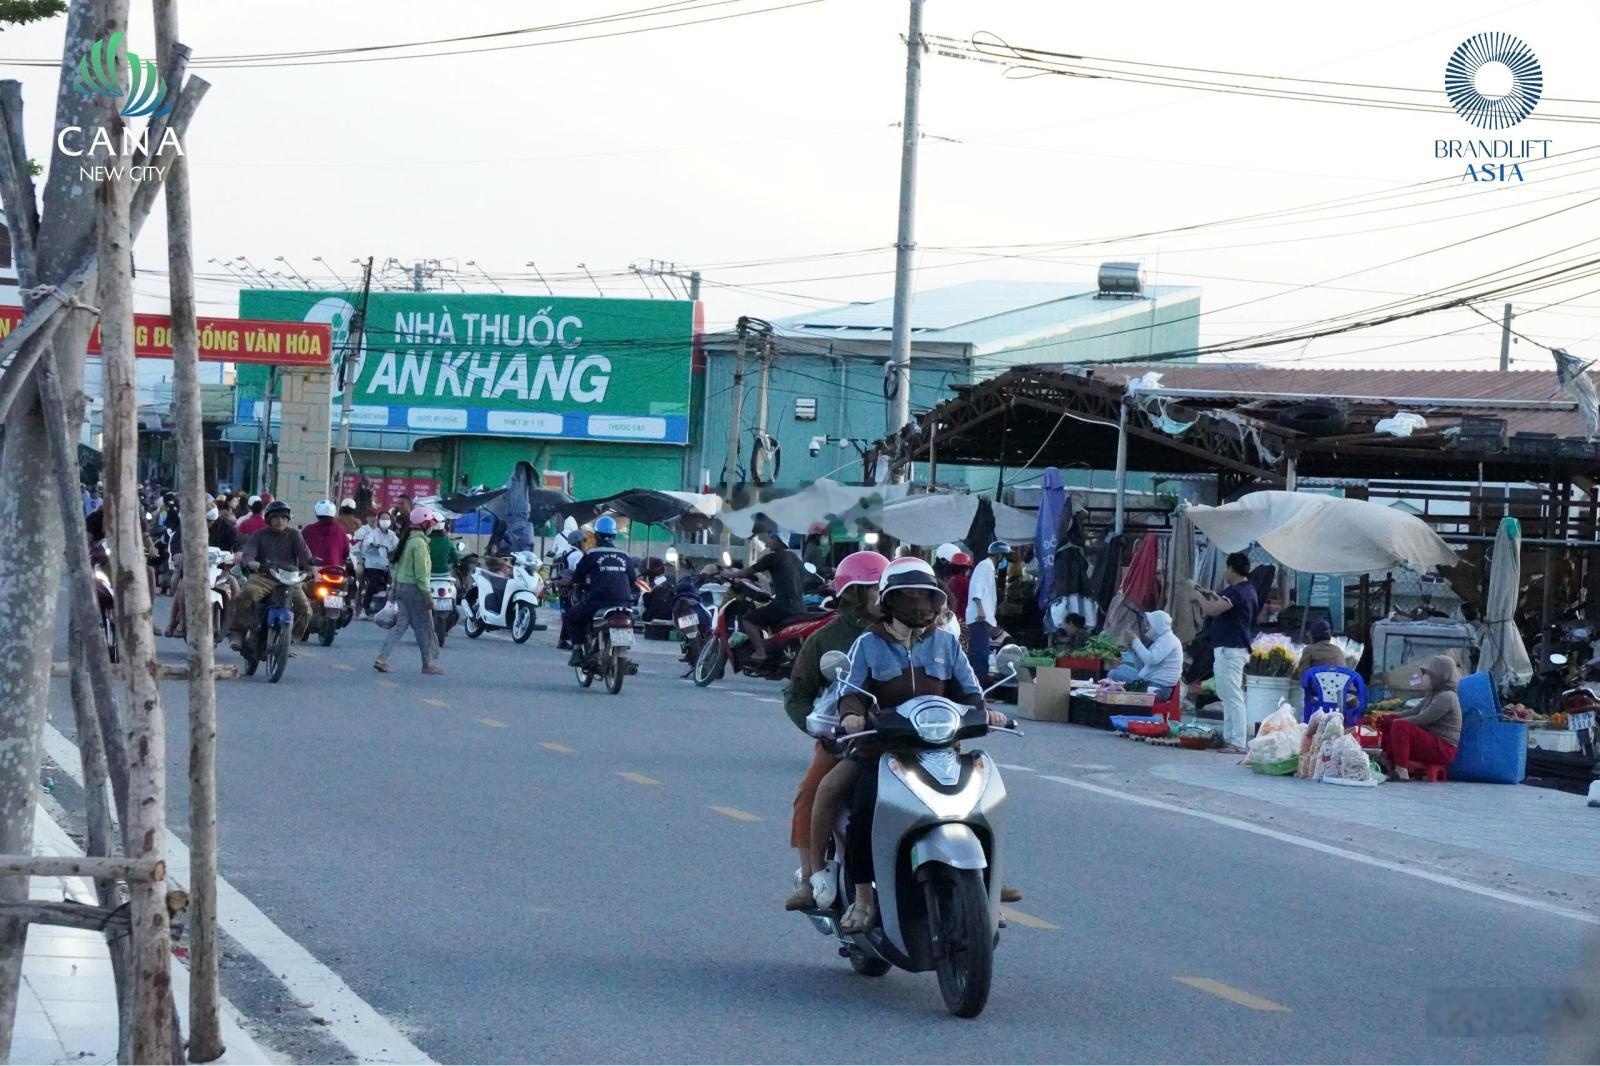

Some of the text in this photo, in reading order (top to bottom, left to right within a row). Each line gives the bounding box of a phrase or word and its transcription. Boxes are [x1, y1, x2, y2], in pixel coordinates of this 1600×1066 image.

[245, 328, 281, 353] VĂN
[286, 330, 322, 355] HÓA
[395, 305, 583, 349] NHÀ THUỐC
[366, 349, 613, 403] AN KHANG
